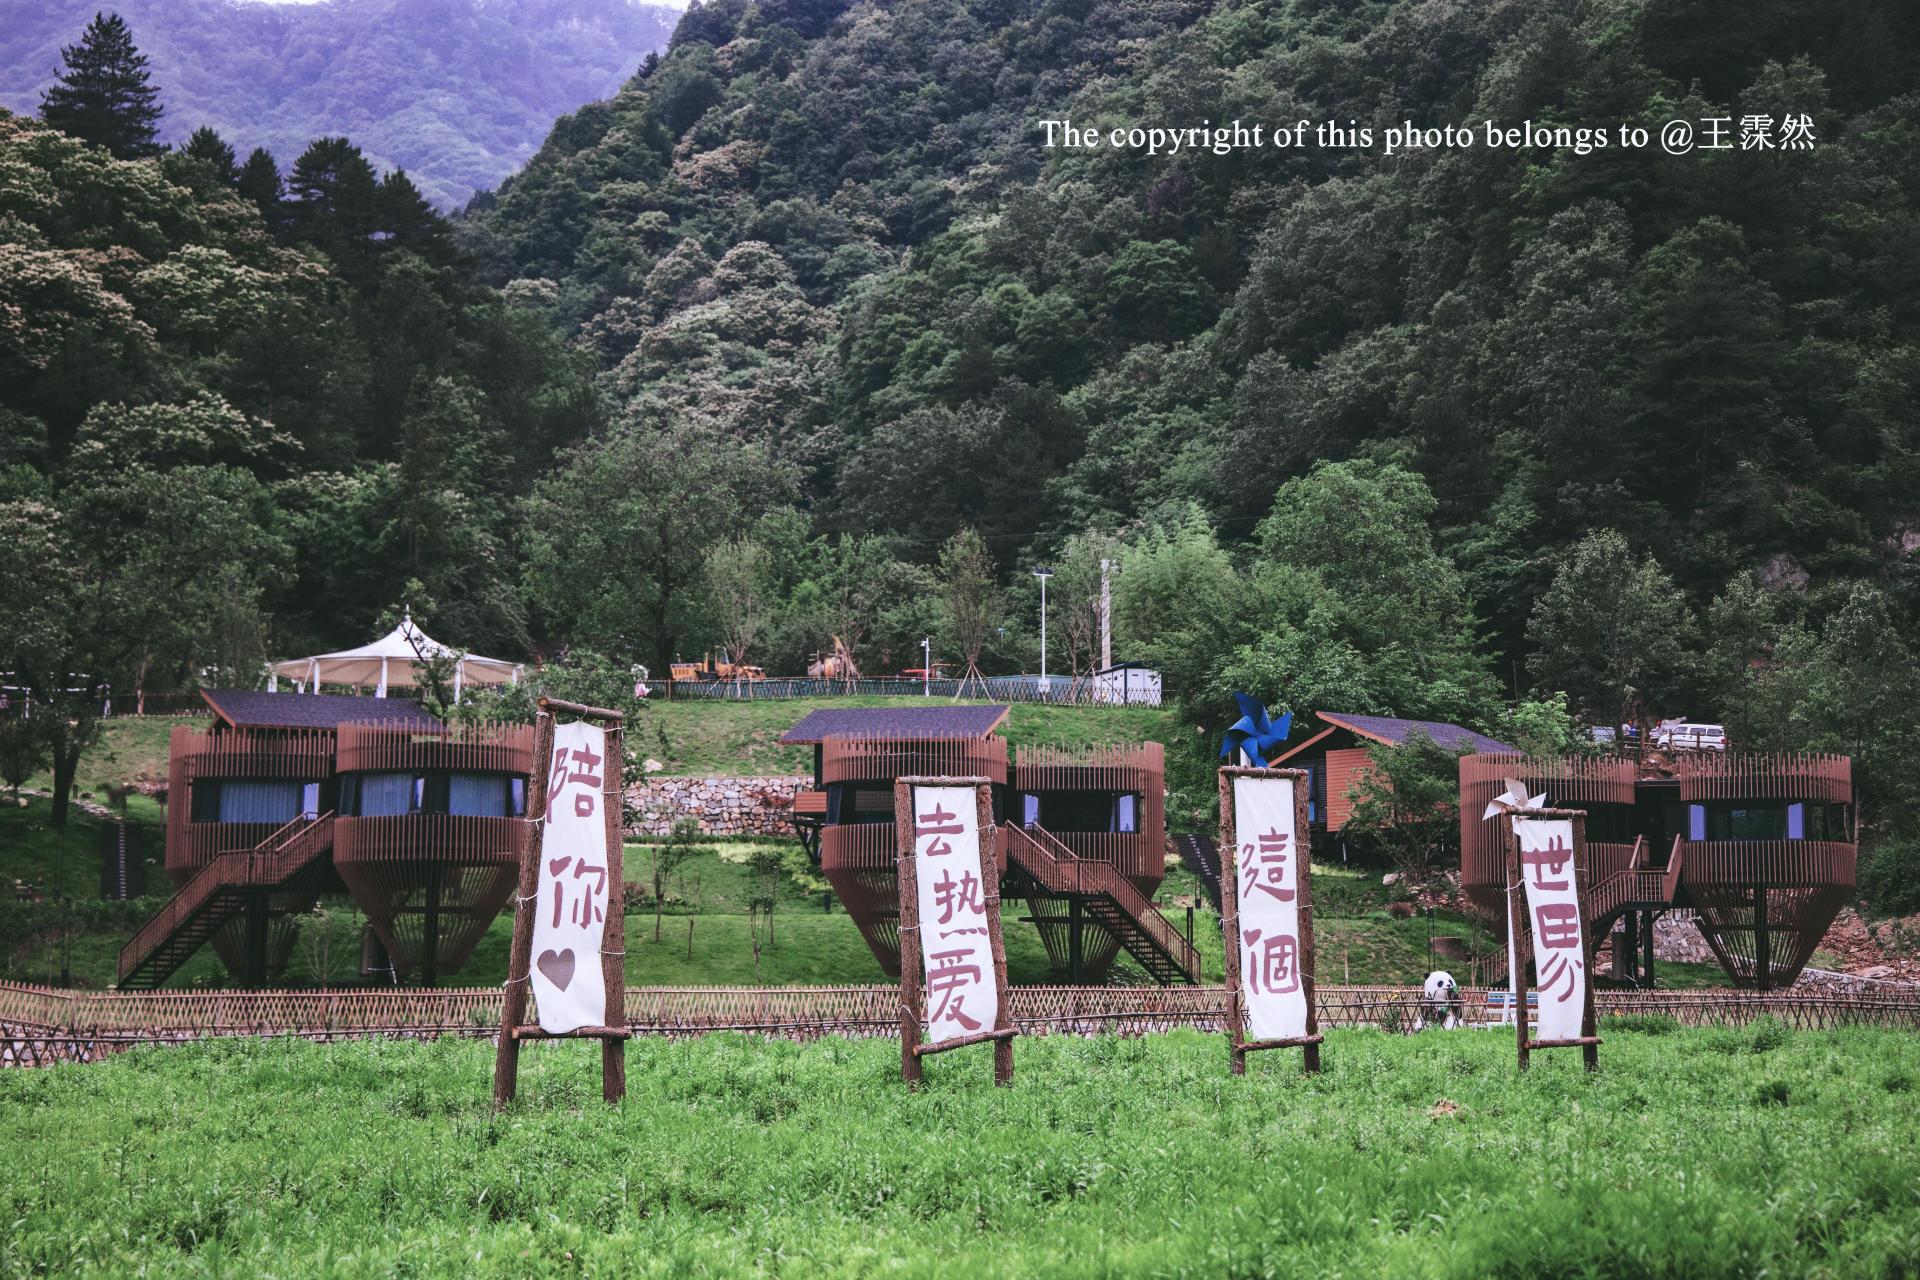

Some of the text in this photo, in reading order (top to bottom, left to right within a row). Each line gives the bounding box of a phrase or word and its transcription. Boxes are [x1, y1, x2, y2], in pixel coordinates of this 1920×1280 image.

[546, 743, 608, 930] 陪你
[916, 801, 989, 1031] 去热爱
[1522, 834, 1583, 1003] 世界
